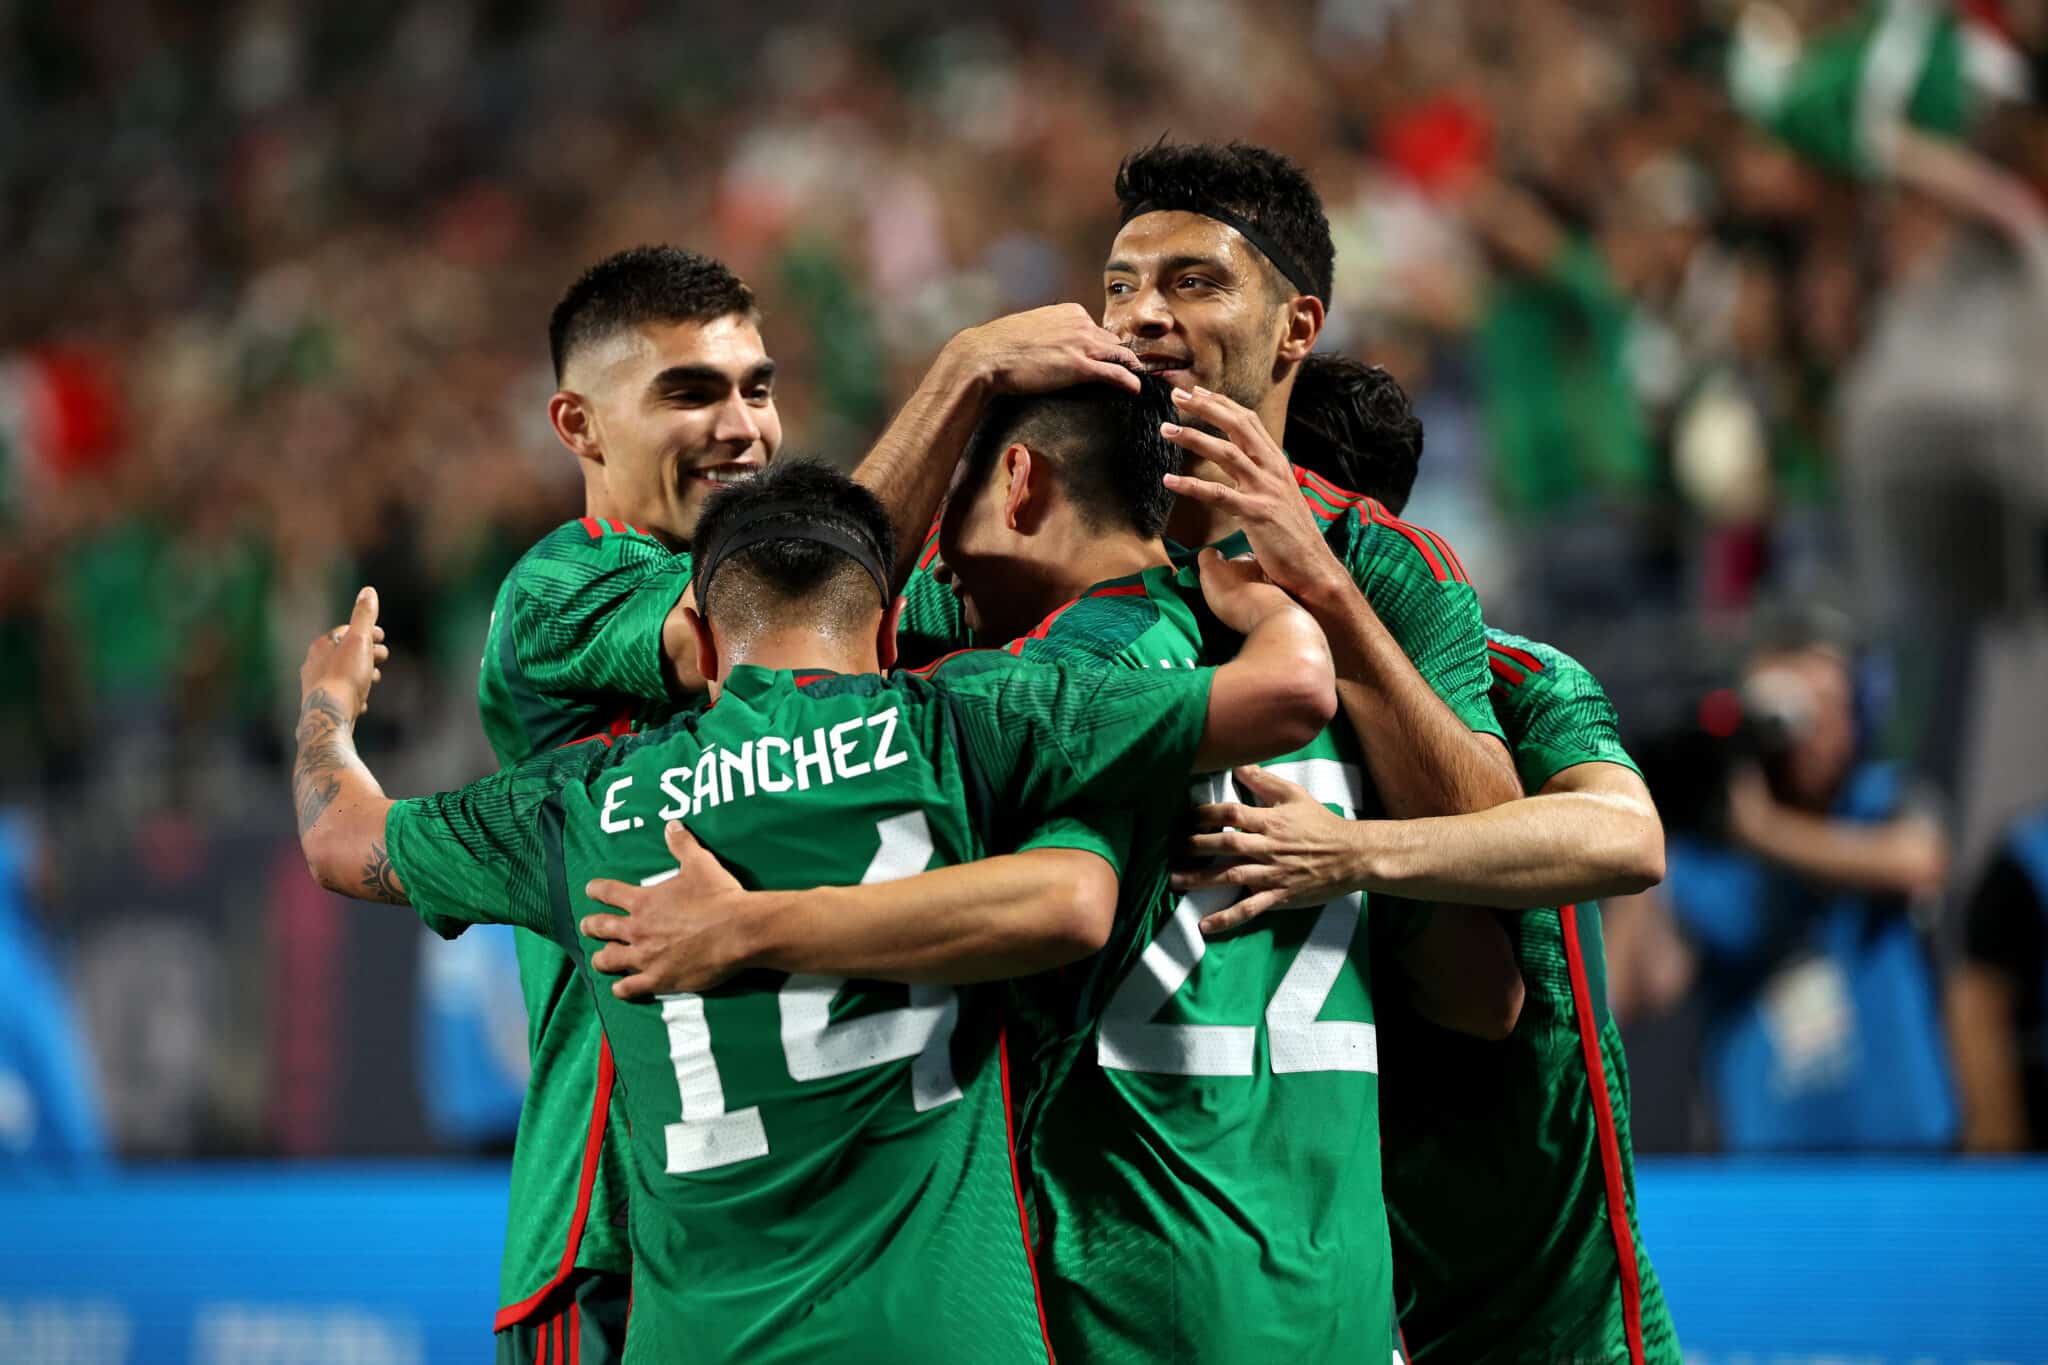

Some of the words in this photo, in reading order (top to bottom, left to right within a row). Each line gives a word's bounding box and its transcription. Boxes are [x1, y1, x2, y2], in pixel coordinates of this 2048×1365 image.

[600, 776, 644, 834] E.
[658, 706, 908, 822] SÁNCHEZ
[640, 809, 964, 1174] 14
